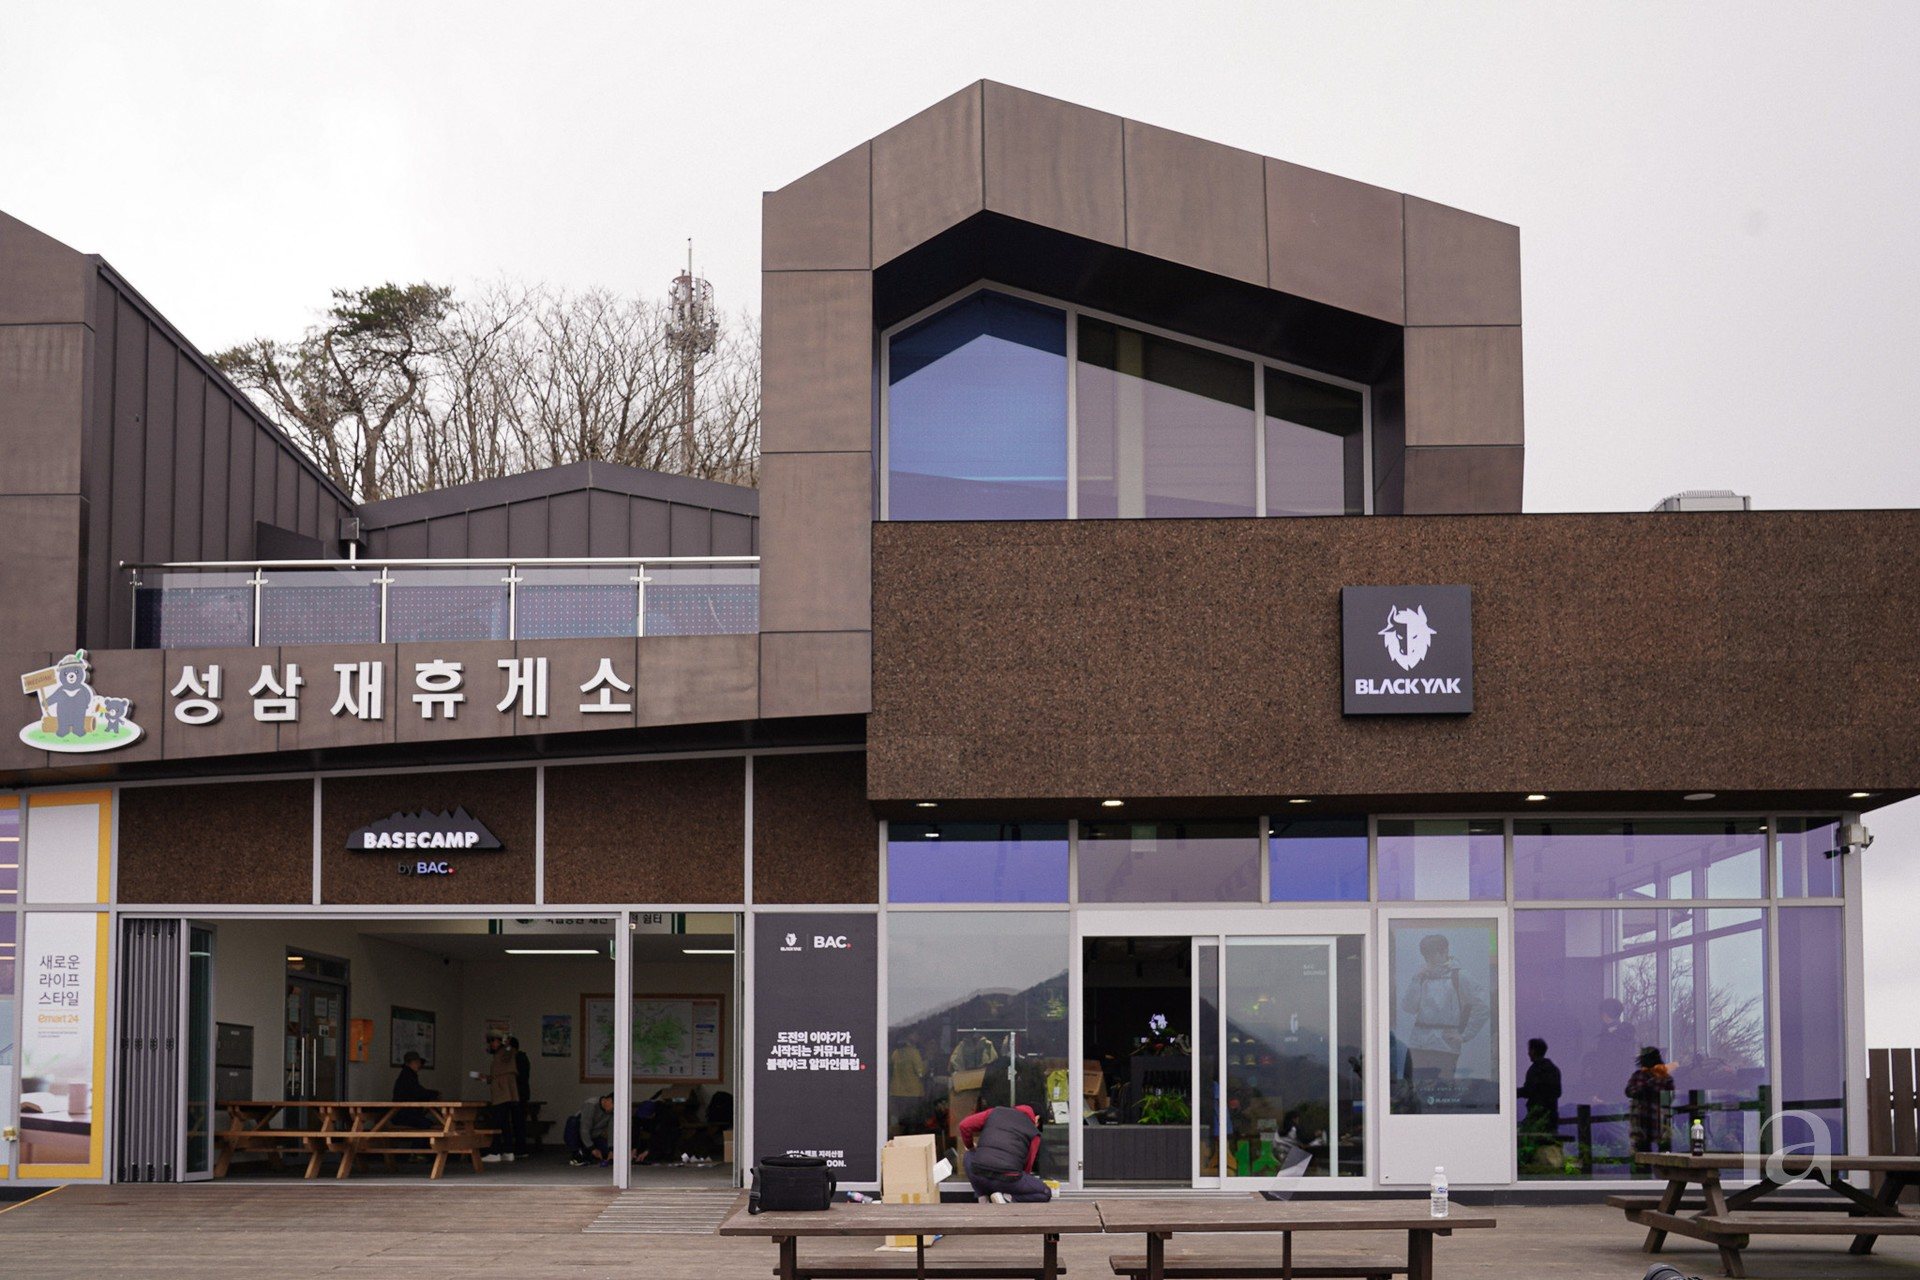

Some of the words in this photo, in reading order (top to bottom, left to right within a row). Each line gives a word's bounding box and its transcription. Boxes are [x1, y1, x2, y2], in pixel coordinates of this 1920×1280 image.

[363, 831, 480, 849] BASECAMP
[397, 862, 413, 875] by
[40, 954, 80, 970] 새로운
[39, 973, 80, 988] 라이프
[38, 991, 79, 1006] 스타일
[776, 1030, 808, 1044] 도전의
[809, 1030, 851, 1044] 이야기가
[770, 1044, 812, 1057] 시작되는
[813, 1044, 858, 1059] 커뮤니티,
